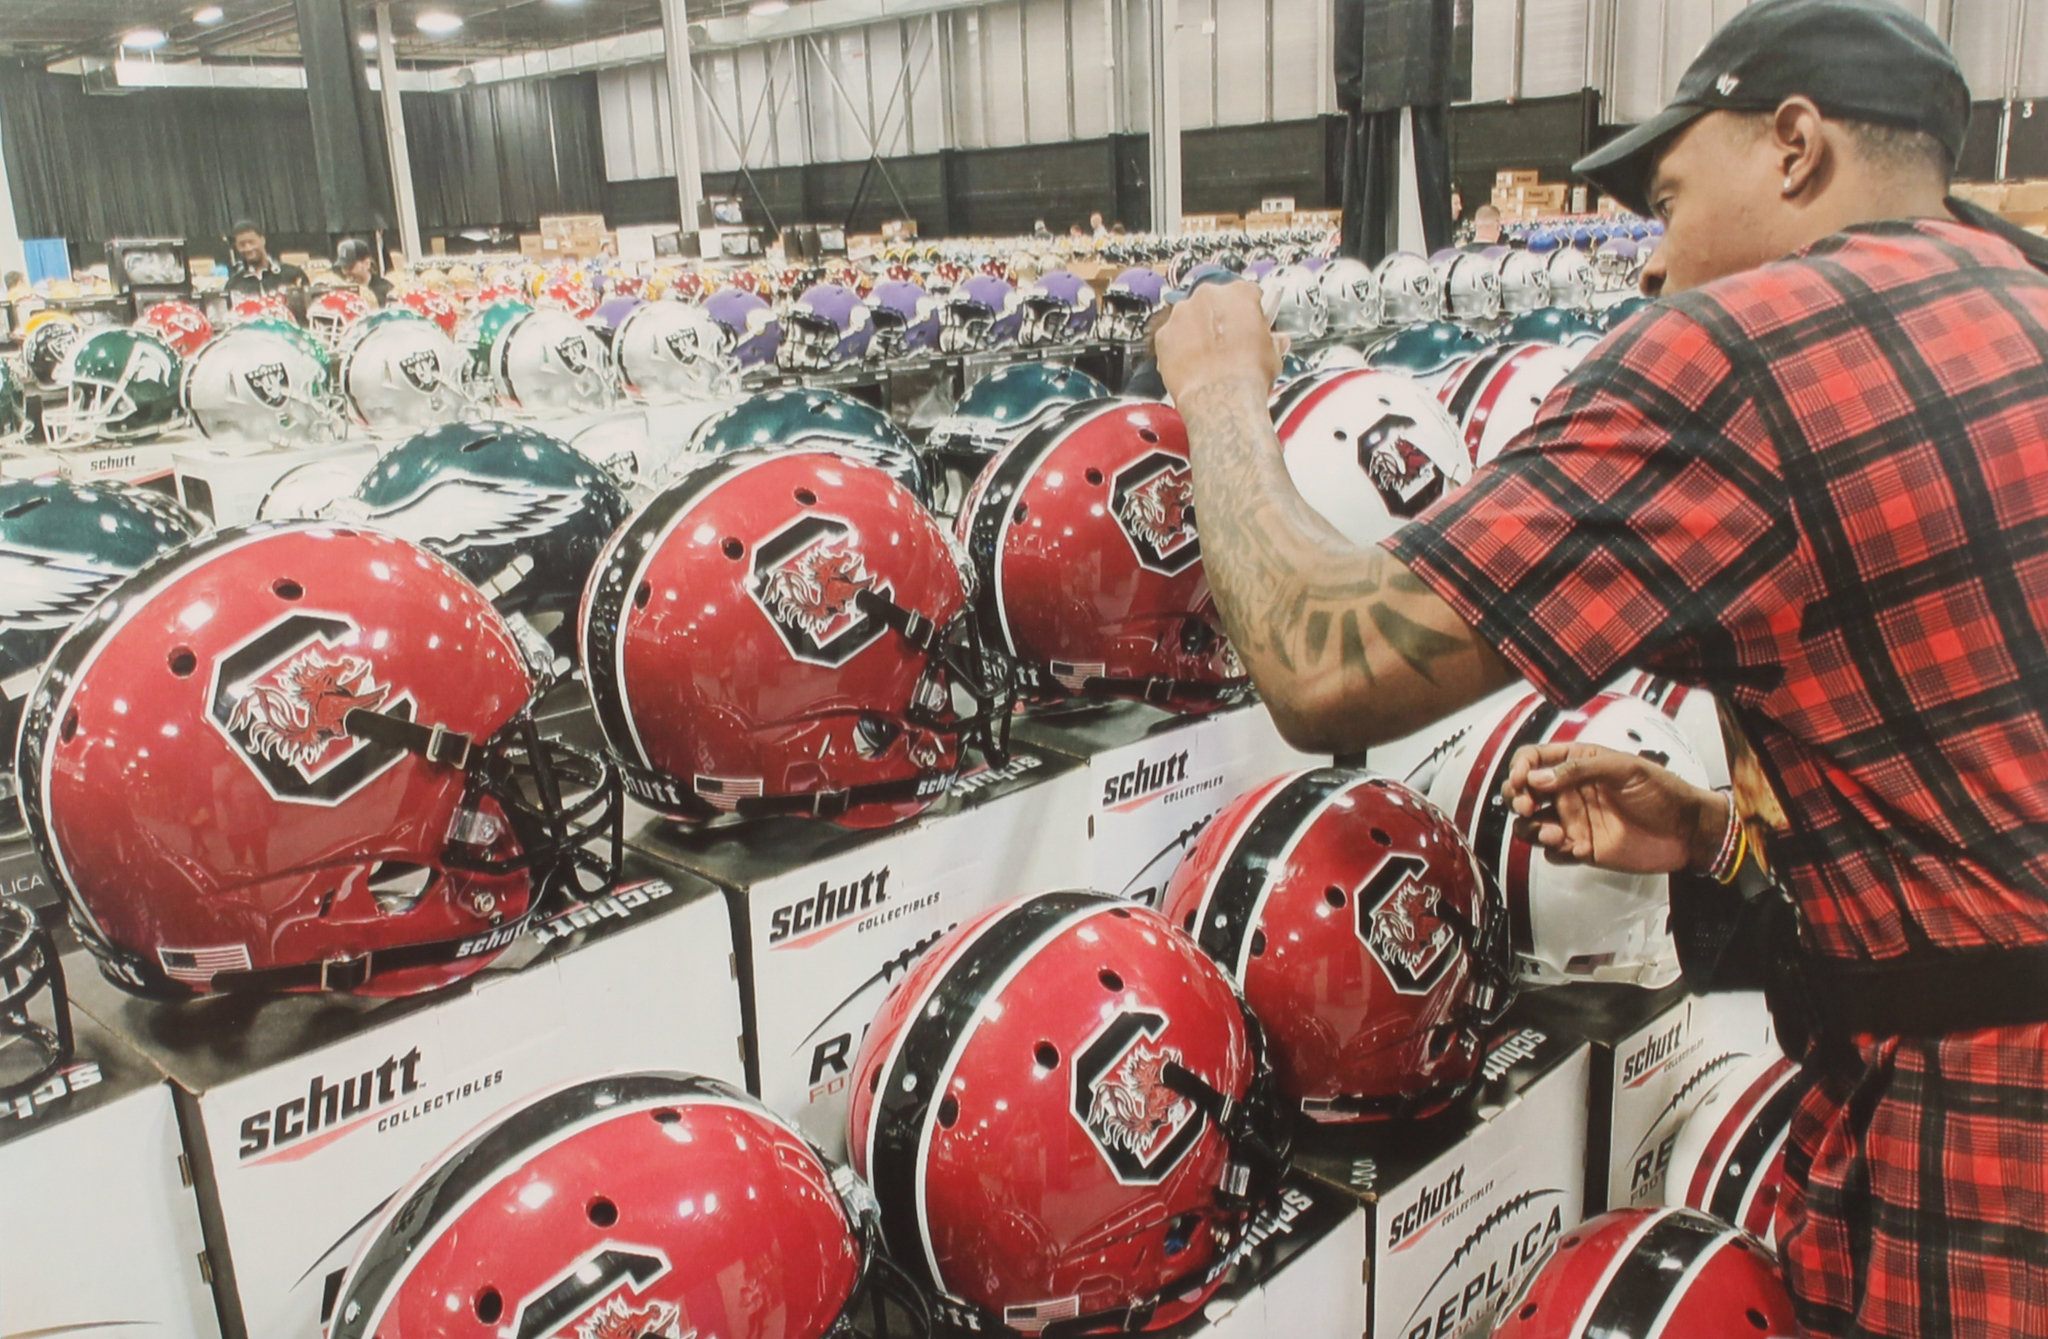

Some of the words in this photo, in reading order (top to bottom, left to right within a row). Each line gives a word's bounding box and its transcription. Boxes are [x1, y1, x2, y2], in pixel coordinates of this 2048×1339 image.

[2022, 100, 2034, 119] 3
[89, 454, 137, 472] schutt
[1102, 748, 1189, 806] schutt
[1163, 775, 1224, 805] COLLECTIBLES
[769, 864, 890, 944] schutt
[857, 891, 941, 934] COLLECTIBLES
[1482, 1028, 1548, 1082] schutt
[1622, 1020, 1682, 1085] schutt
[239, 1045, 421, 1160] schutt
[377, 1069, 504, 1134] COLLECTIBLES
[1388, 1162, 1465, 1249] schutt
